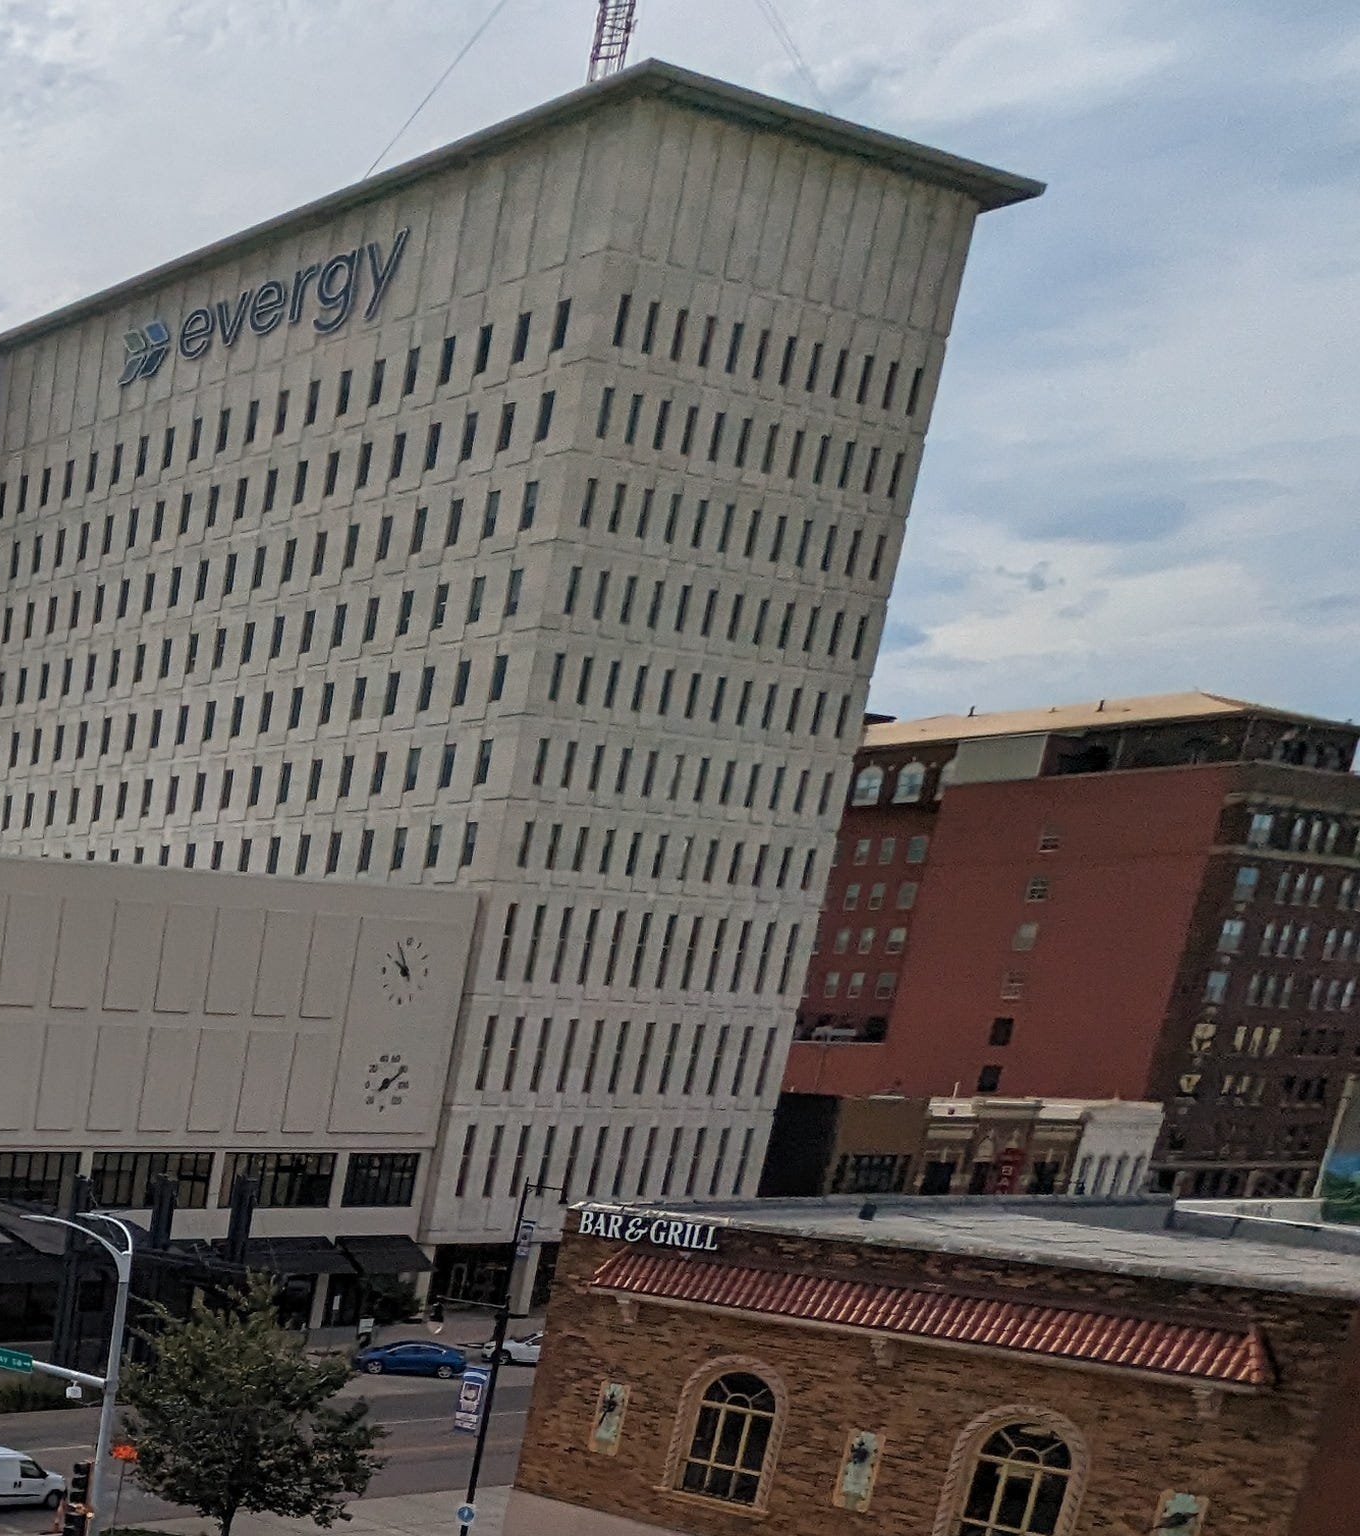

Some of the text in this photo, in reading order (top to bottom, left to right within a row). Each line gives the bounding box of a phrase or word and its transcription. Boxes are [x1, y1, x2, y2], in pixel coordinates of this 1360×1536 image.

[180, 226, 409, 360] evergy
[578, 1211, 717, 1250] BAR & GRILL
